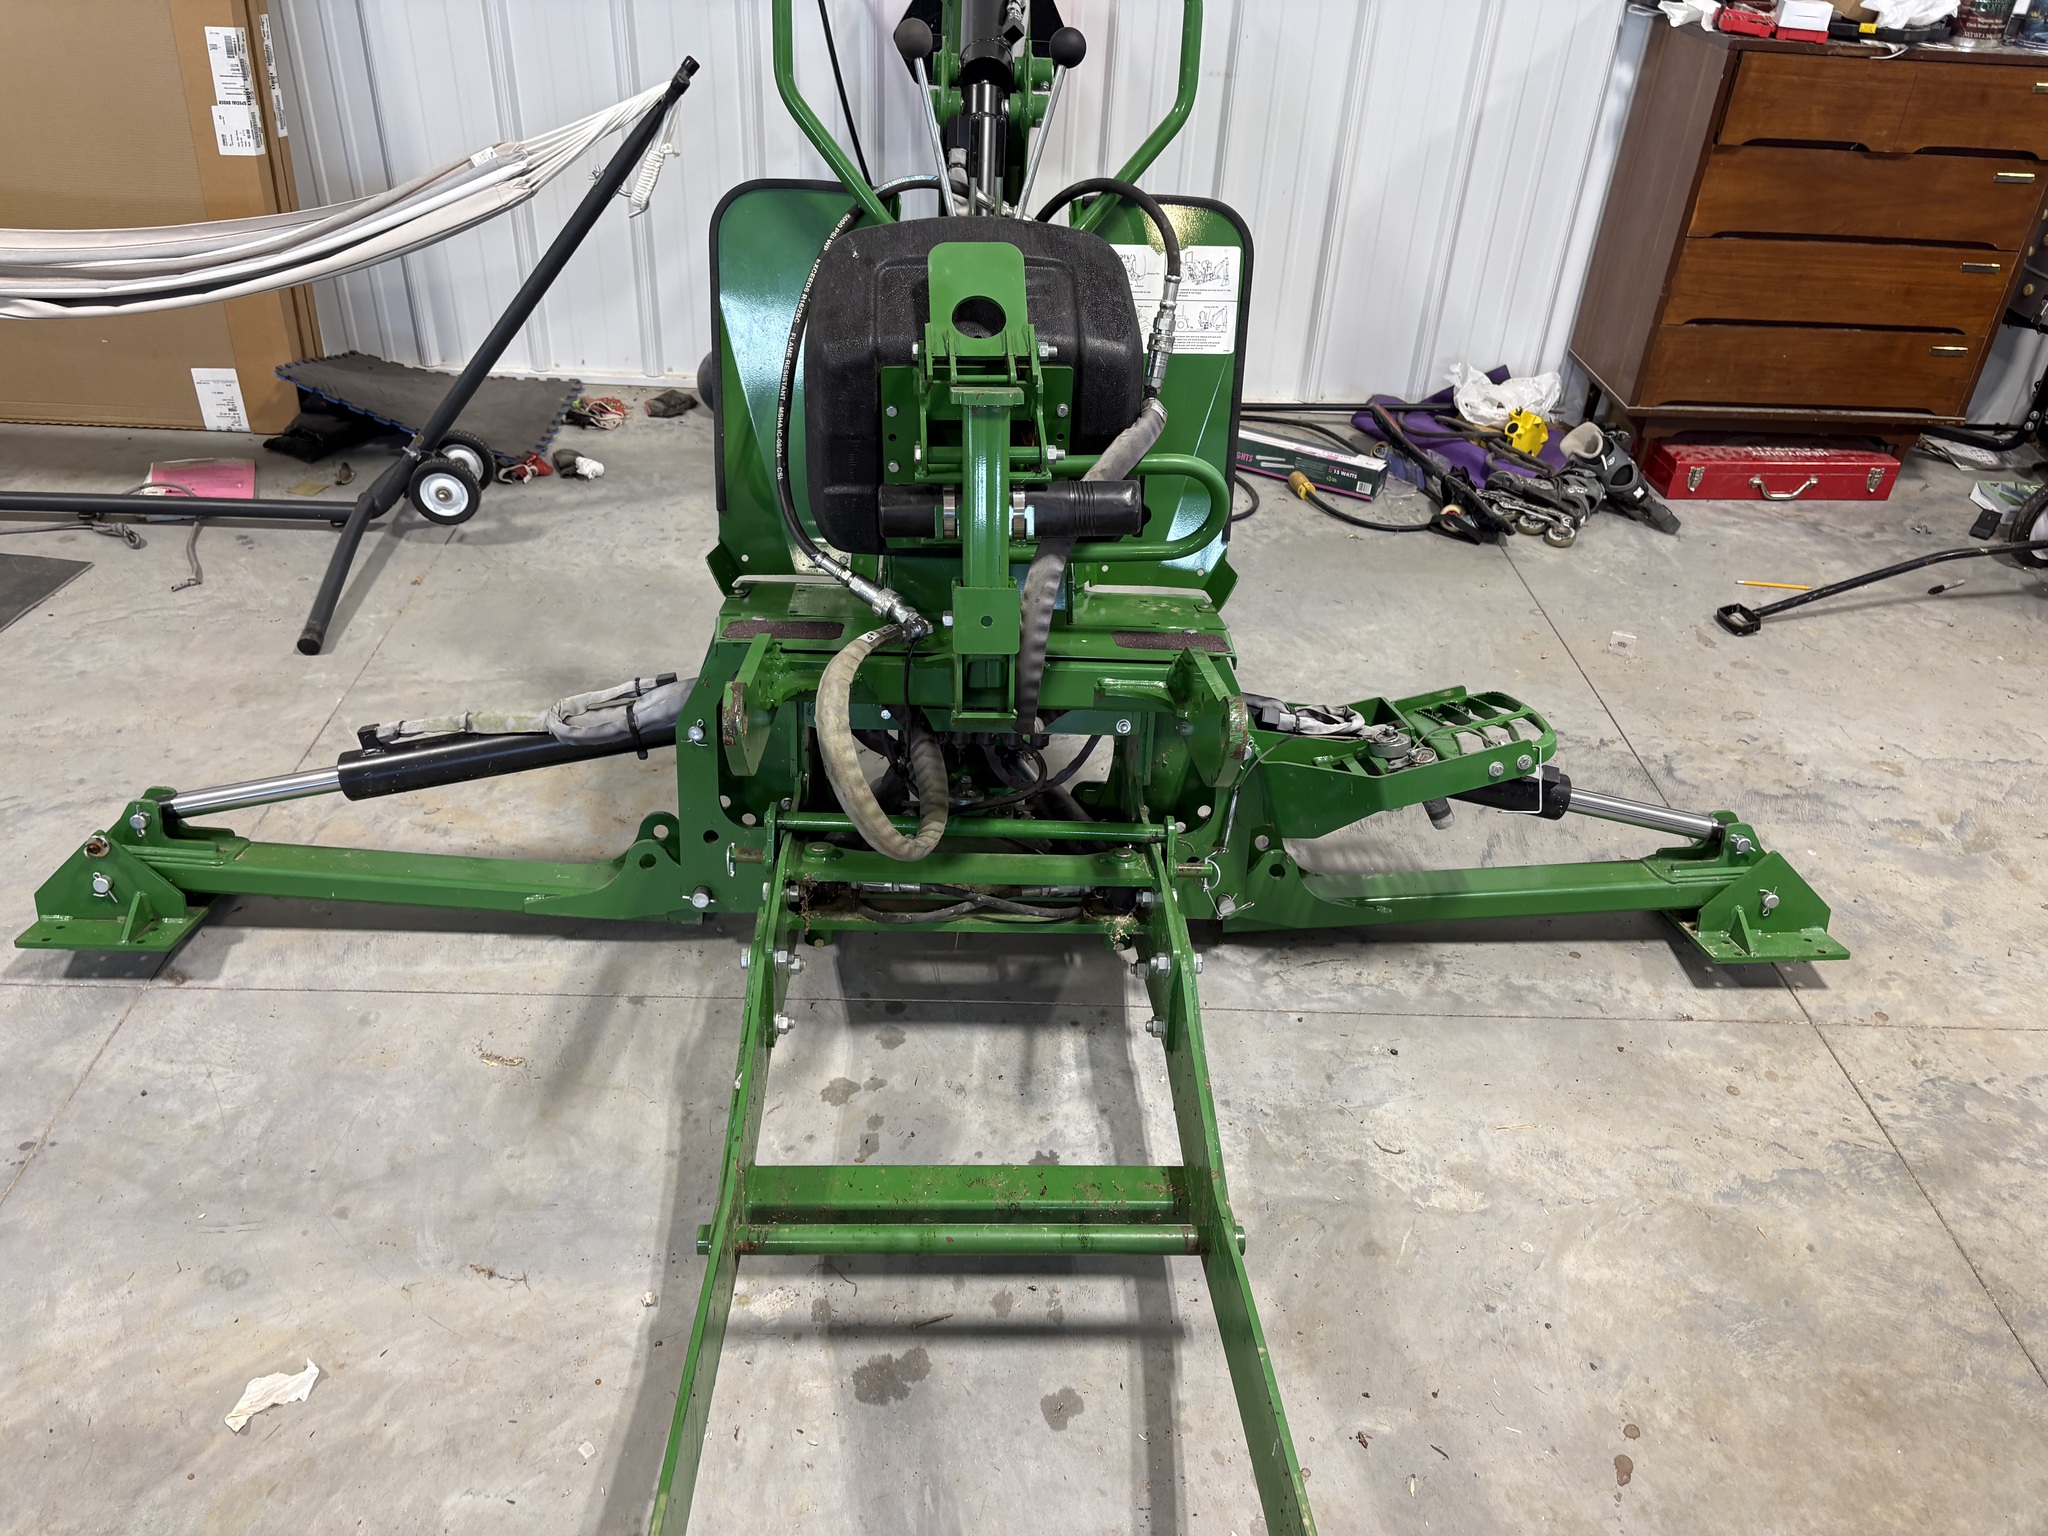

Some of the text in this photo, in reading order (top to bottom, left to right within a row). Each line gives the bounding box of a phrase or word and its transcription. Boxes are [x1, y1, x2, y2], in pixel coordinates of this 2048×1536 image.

[829, 227, 840, 240] PSI
[823, 239, 833, 251] WP
[804, 259, 821, 293] EXCEEDS
[785, 332, 797, 359] FLAME
[780, 359, 791, 401] RESISTANT
[777, 406, 785, 428] MSHA
[1236, 451, 1254, 463] GHTS
[1340, 471, 1358, 480] WATTS
